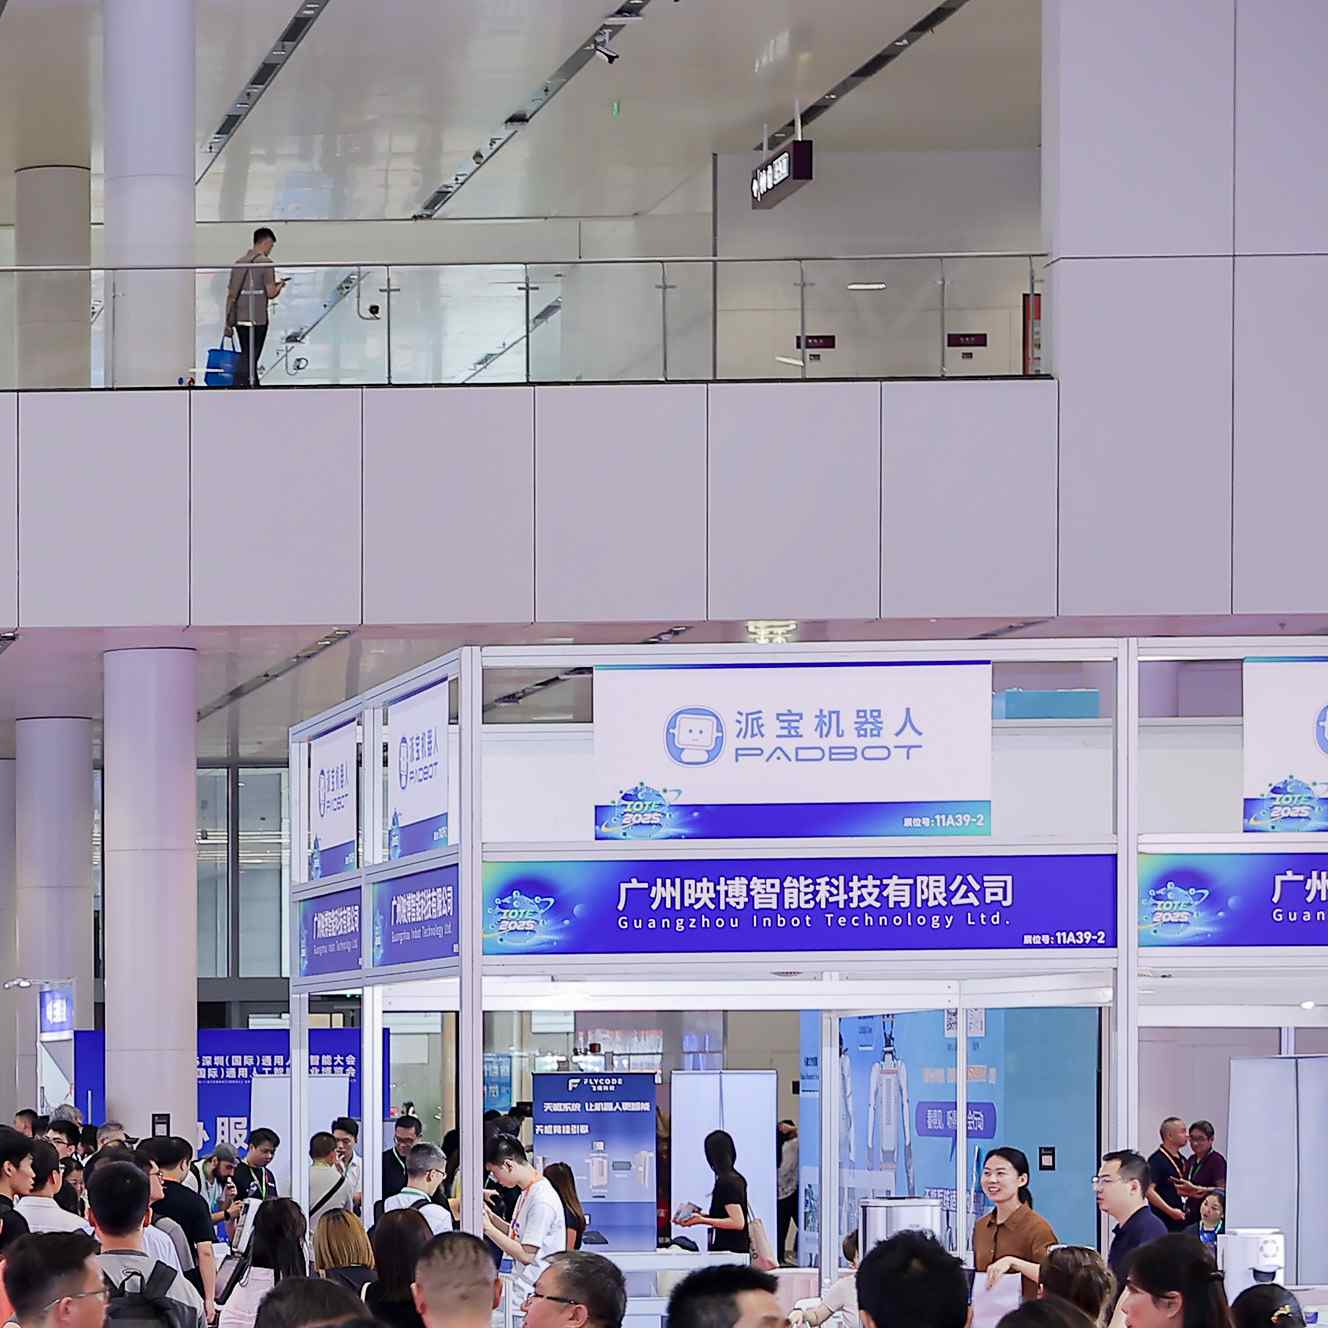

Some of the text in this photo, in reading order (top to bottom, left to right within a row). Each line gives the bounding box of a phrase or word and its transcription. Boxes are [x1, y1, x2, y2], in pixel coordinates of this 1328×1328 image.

[735, 706, 923, 739] 派宝机器人
[735, 744, 923, 763] PADBOT
[622, 813, 663, 825] 2025
[1270, 806, 1312, 817] 2025
[617, 875, 1014, 911] 广州映博智能科技有限公司
[1272, 870, 1328, 903] 广州
[618, 911, 1011, 932] Guangzhou Inbot Technology Ltd.
[1152, 911, 1191, 922] 2025
[1273, 908, 1325, 922] Guan
[498, 920, 536, 931] 2025
